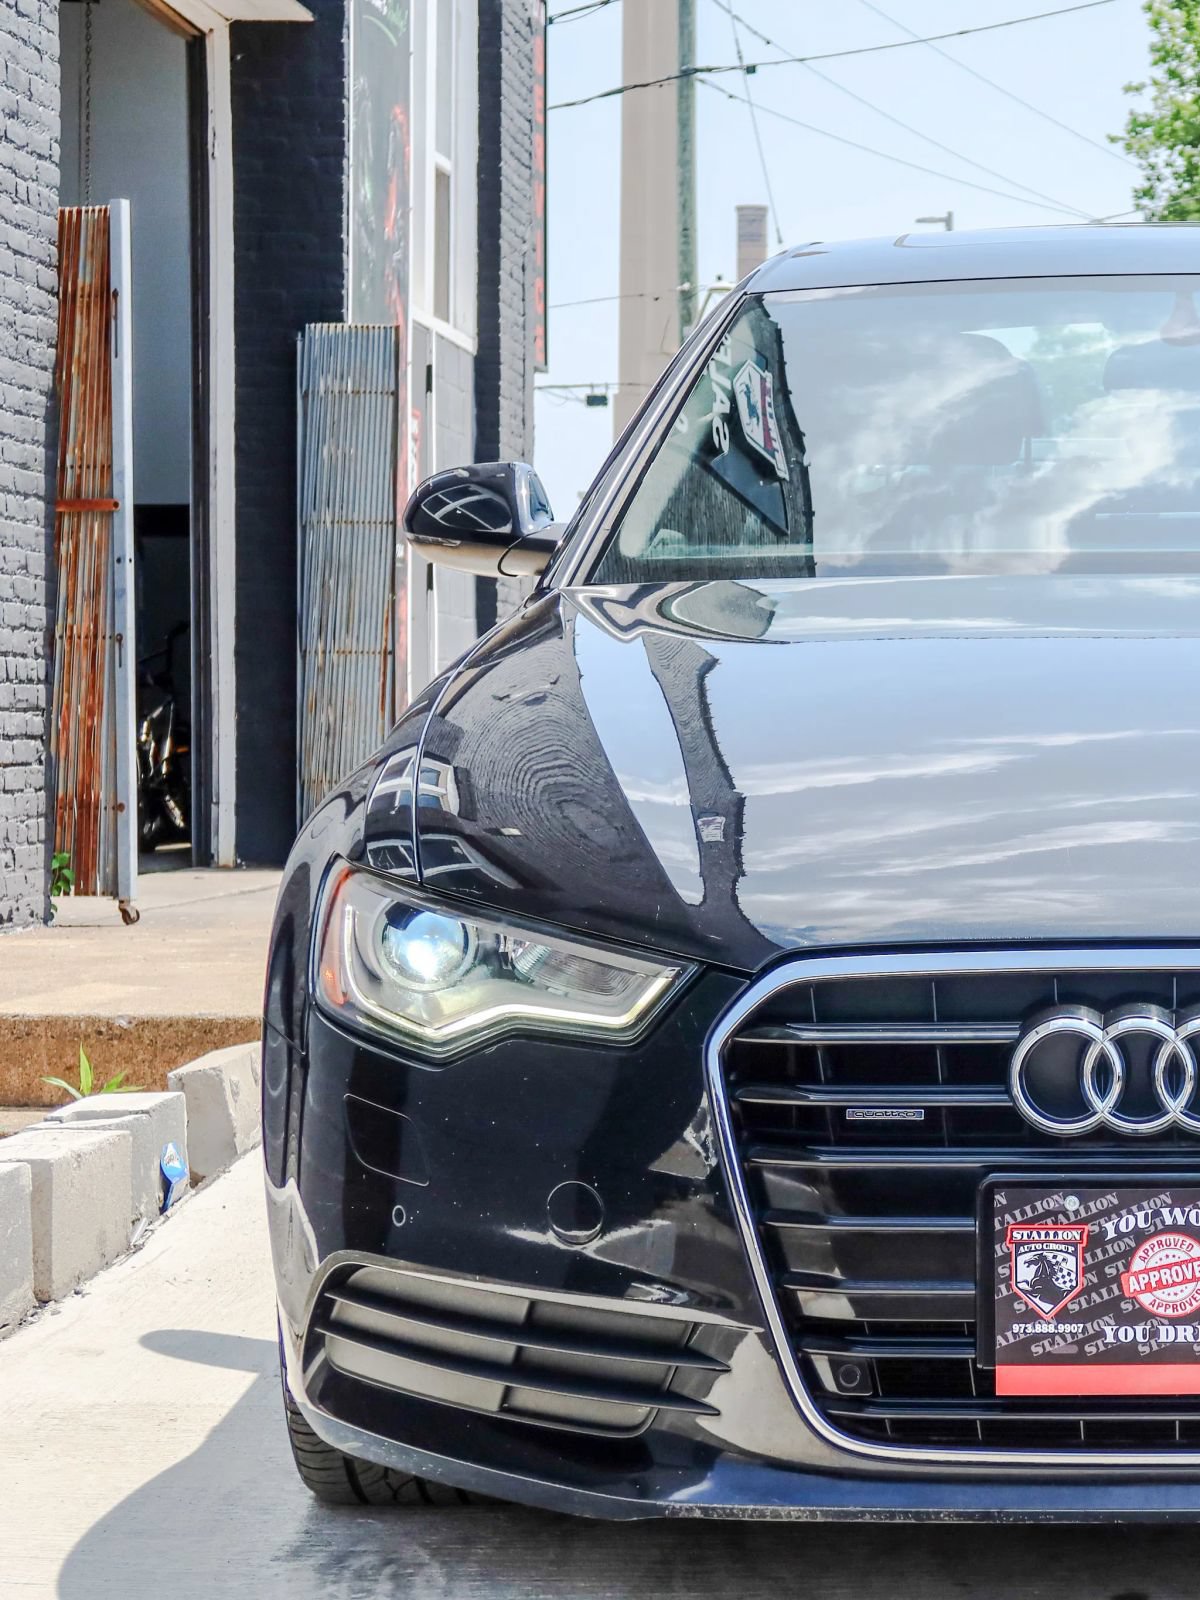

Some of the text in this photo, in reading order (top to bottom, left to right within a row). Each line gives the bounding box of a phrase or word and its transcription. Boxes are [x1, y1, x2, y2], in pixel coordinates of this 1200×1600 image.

[854, 1109, 916, 1119] quattro
[994, 1192, 1064, 1231] TALLION
[1036, 1192, 1119, 1226] TALLION
[1102, 1210, 1153, 1241] YOU
[1012, 1230, 1081, 1241] STALLION
[1018, 1243, 1042, 1254] AUTO
[1043, 1243, 1075, 1254] GROUP
[1138, 1237, 1194, 1263] APPROVED
[1012, 1323, 1084, 1334] 973.888.9907
[1102, 1325, 1151, 1343] YOU
